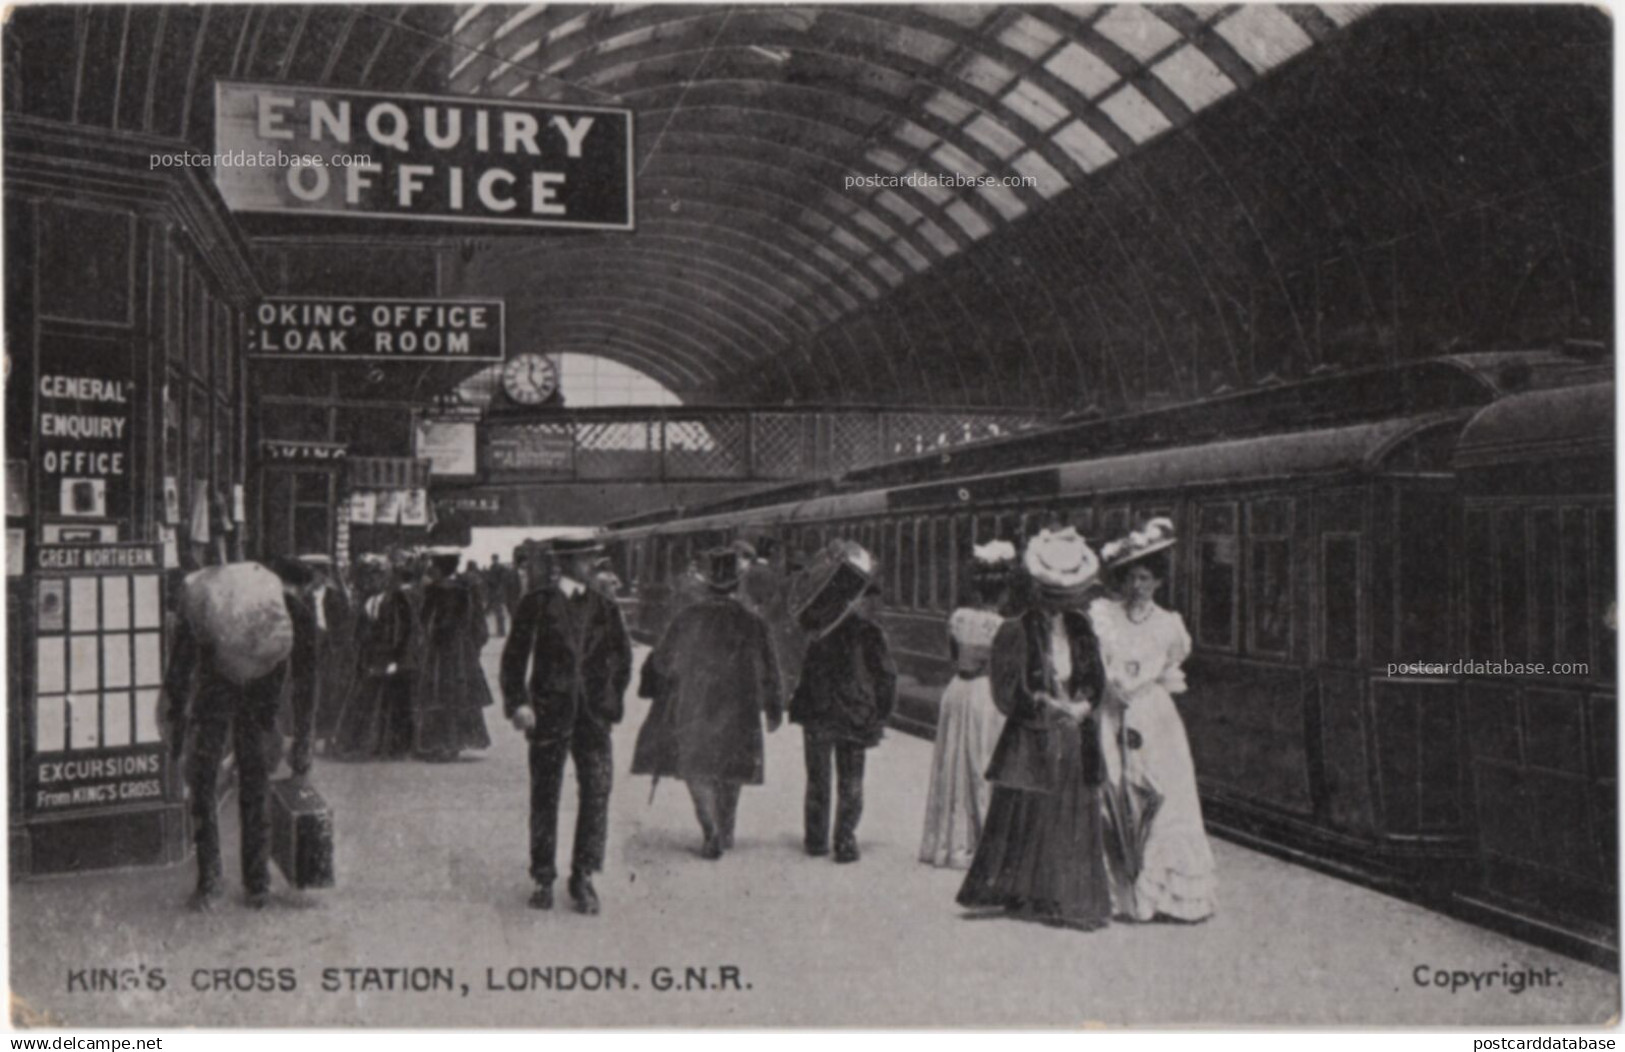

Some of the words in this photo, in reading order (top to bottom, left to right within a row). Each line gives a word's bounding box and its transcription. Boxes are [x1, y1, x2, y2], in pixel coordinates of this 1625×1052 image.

[256, 96, 596, 158] ENQUIRY
[287, 163, 567, 214] OFFICE
[372, 306, 487, 328] OFFICE
[376, 332, 470, 353] ROOM
[41, 375, 126, 402] GENERAL
[41, 413, 125, 439] ENQUIRY
[43, 451, 124, 475] OFFICE
[38, 548, 80, 568] GREAT
[39, 755, 160, 783] EXCURSIONS
[37, 790, 71, 809] From
[120, 779, 161, 798] CROSS
